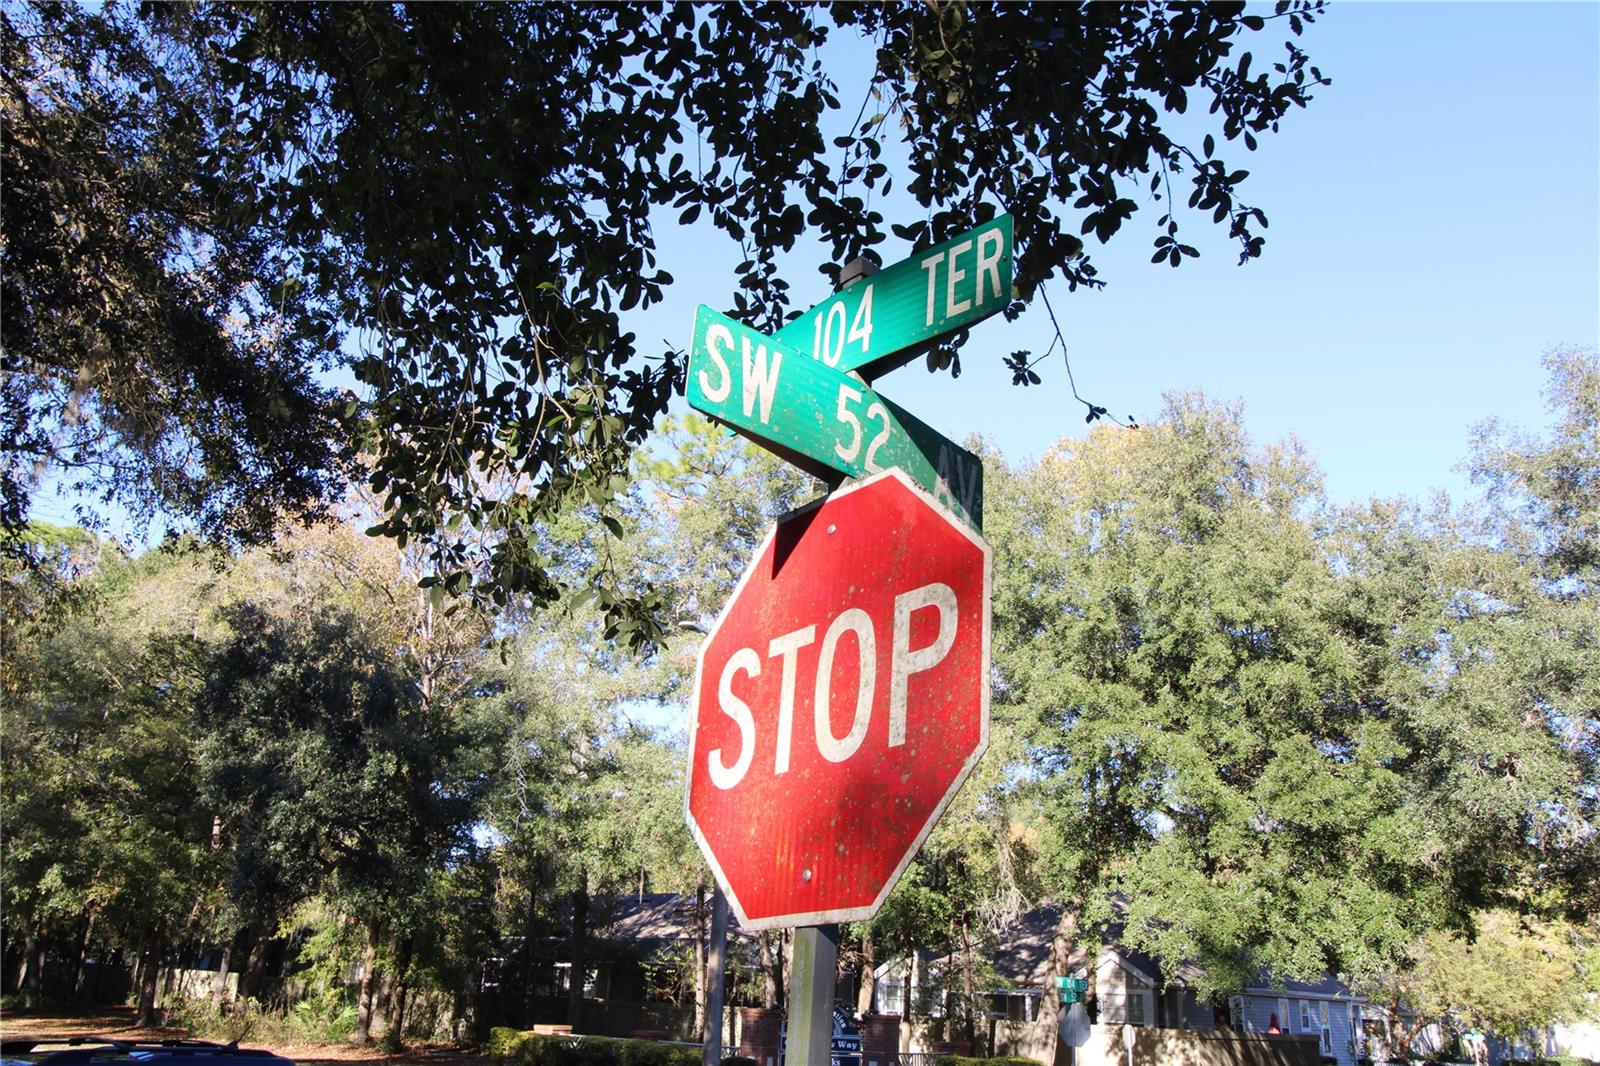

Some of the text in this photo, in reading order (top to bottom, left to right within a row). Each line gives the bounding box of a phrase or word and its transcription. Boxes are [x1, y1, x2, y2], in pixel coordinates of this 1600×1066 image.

[813, 227, 1004, 367] 104 TER
[700, 324, 977, 525] SW 52 AV
[708, 582, 958, 789] STOP
[838, 1040, 857, 1049] Way
